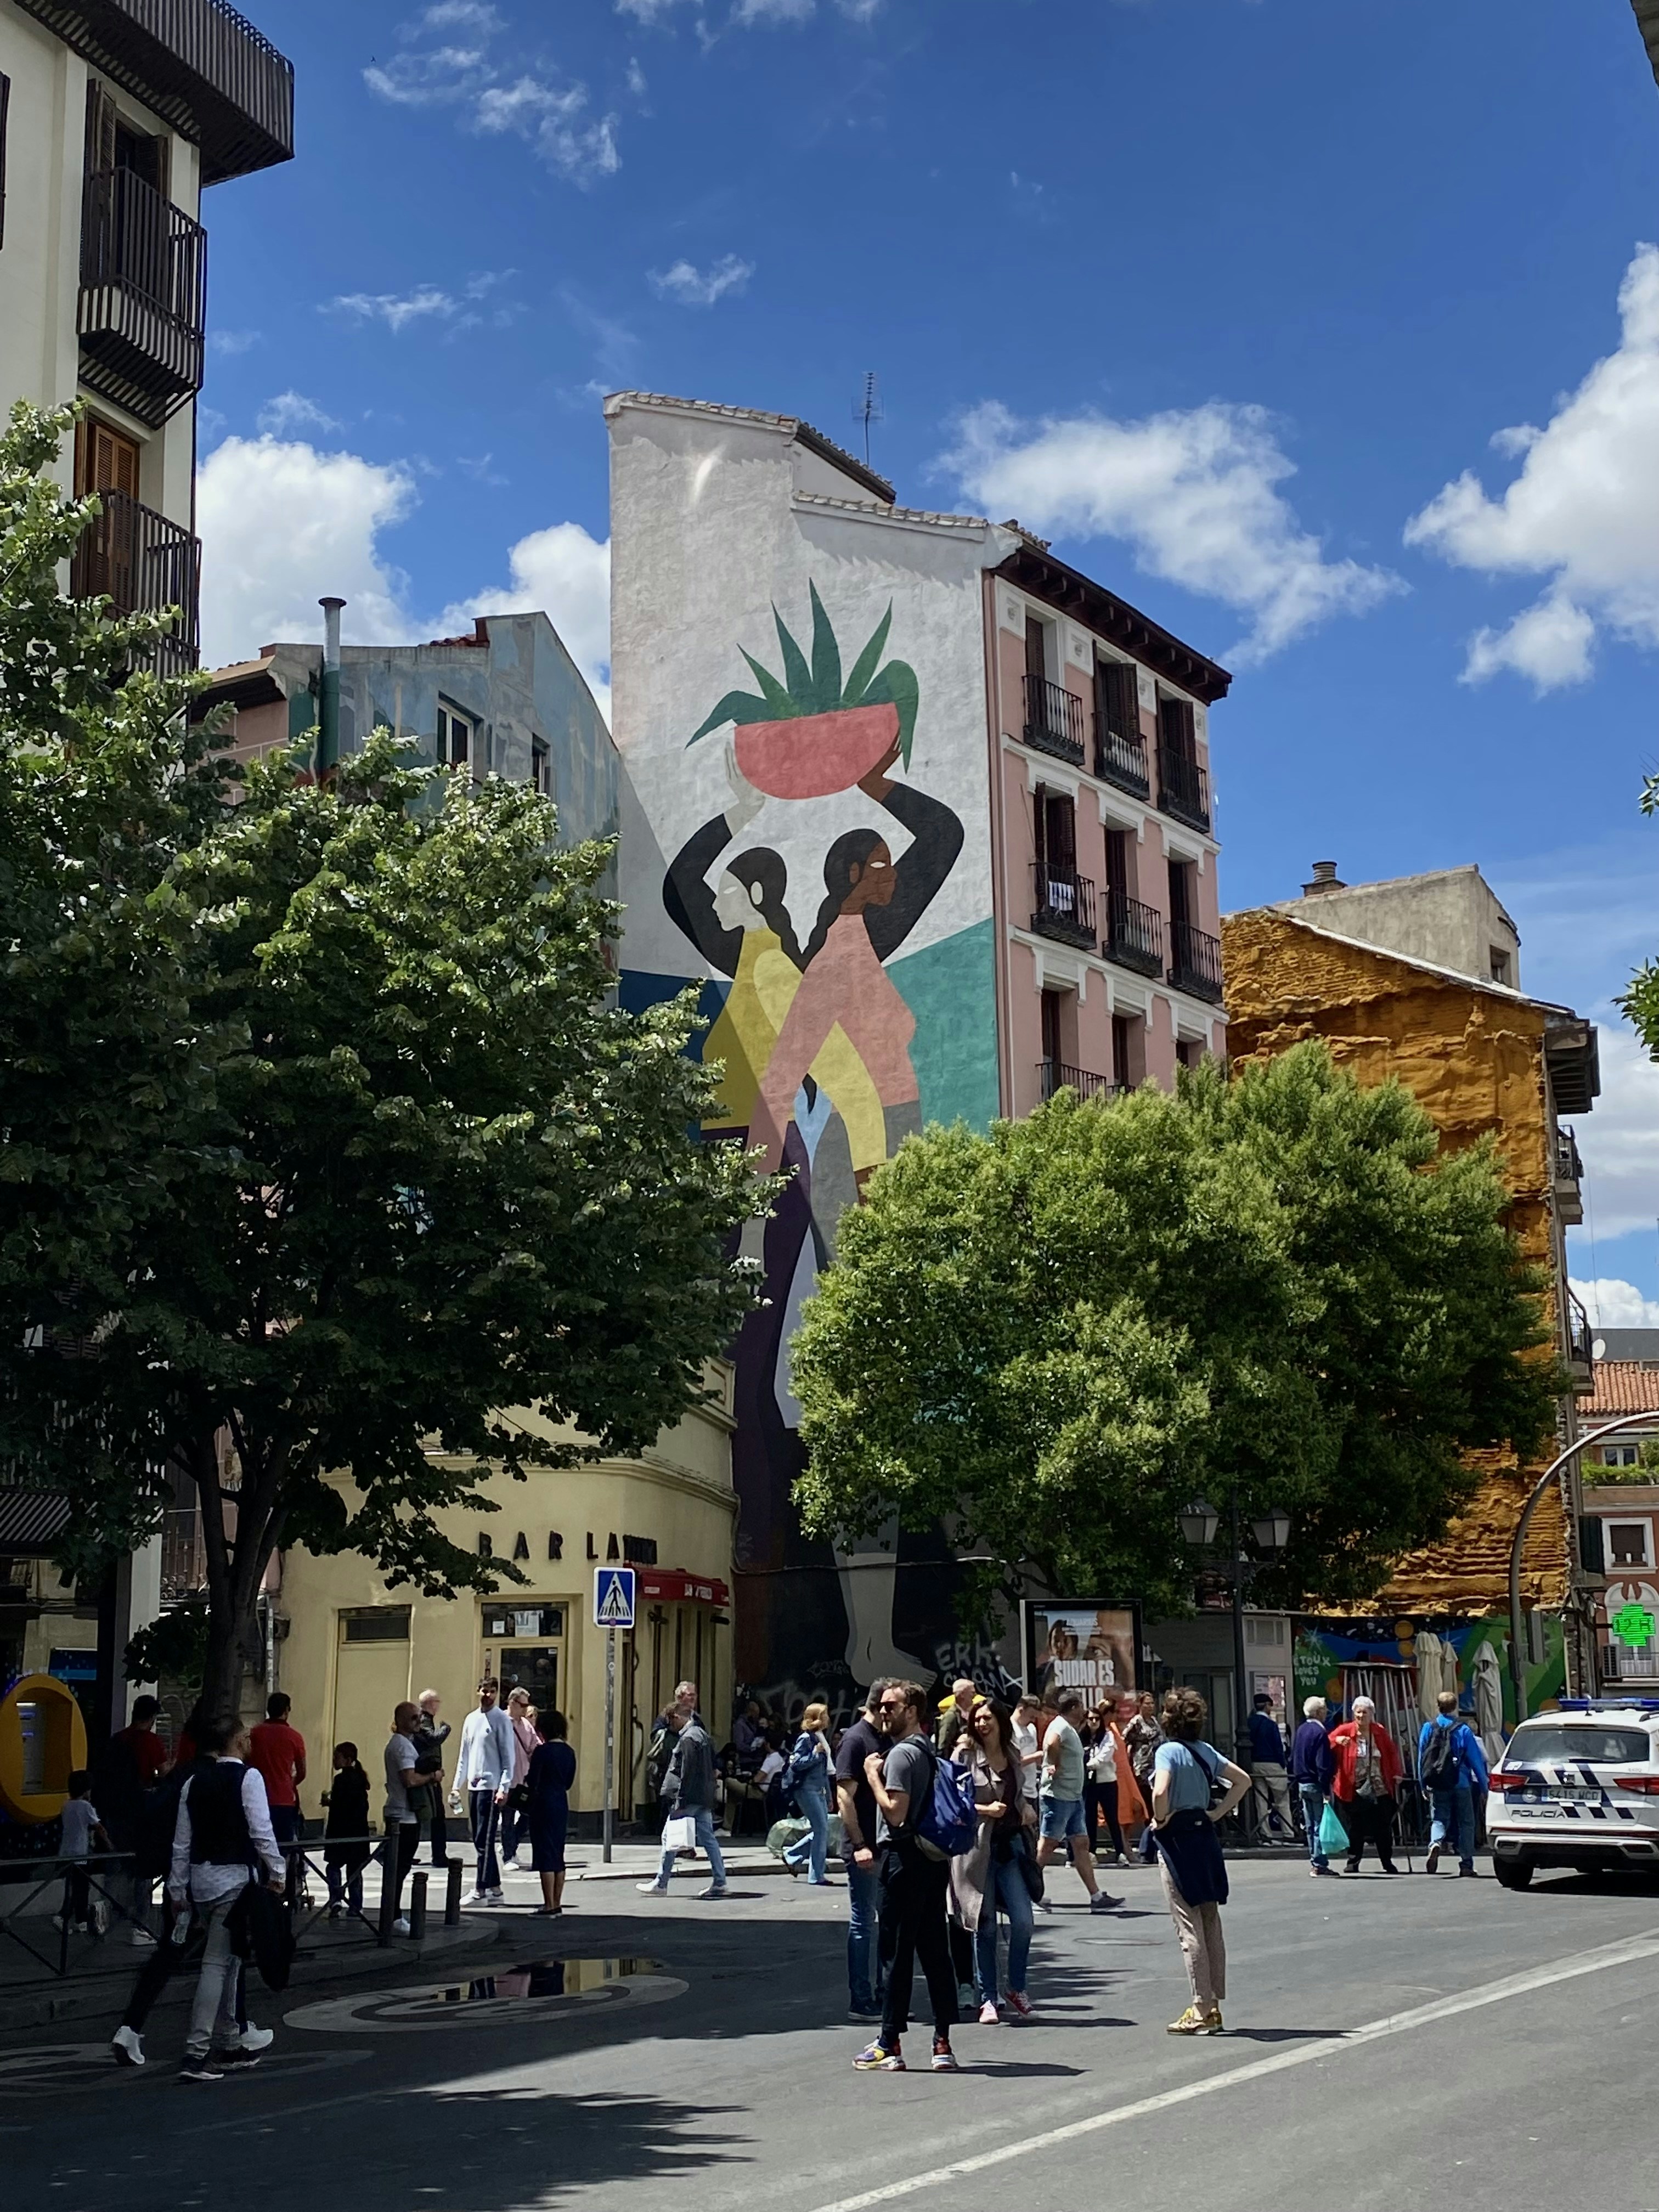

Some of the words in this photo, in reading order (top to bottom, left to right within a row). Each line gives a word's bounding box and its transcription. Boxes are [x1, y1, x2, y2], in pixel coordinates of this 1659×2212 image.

[479, 1530, 563, 1560] BAR
[1054, 1660, 1096, 1687] SUDAR
[1098, 1659, 1115, 1686] ES
